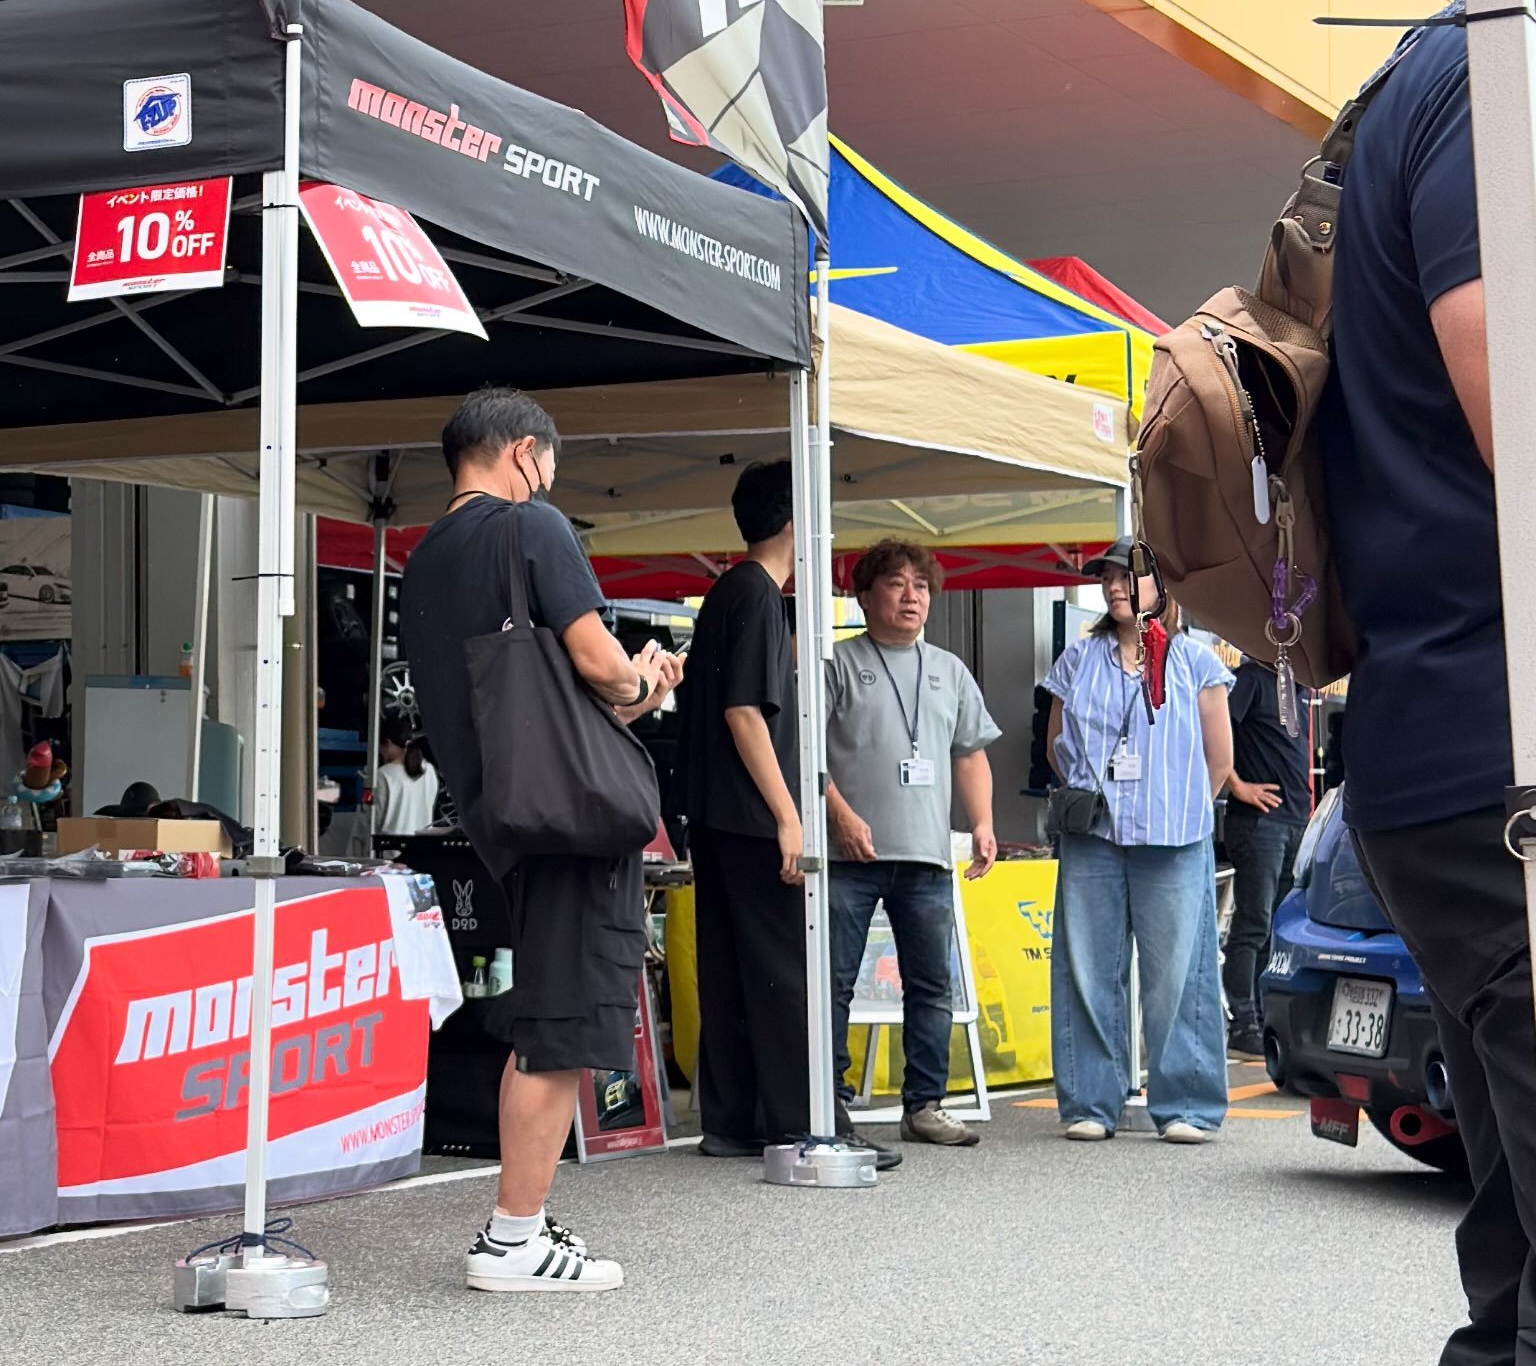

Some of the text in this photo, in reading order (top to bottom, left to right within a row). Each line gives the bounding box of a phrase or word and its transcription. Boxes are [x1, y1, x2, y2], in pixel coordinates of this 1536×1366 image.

[347, 78, 601, 202] monster SPORT
[171, 232, 215, 258] OFF
[633, 205, 781, 292] WWW.MONSTER-SPORT.COM
